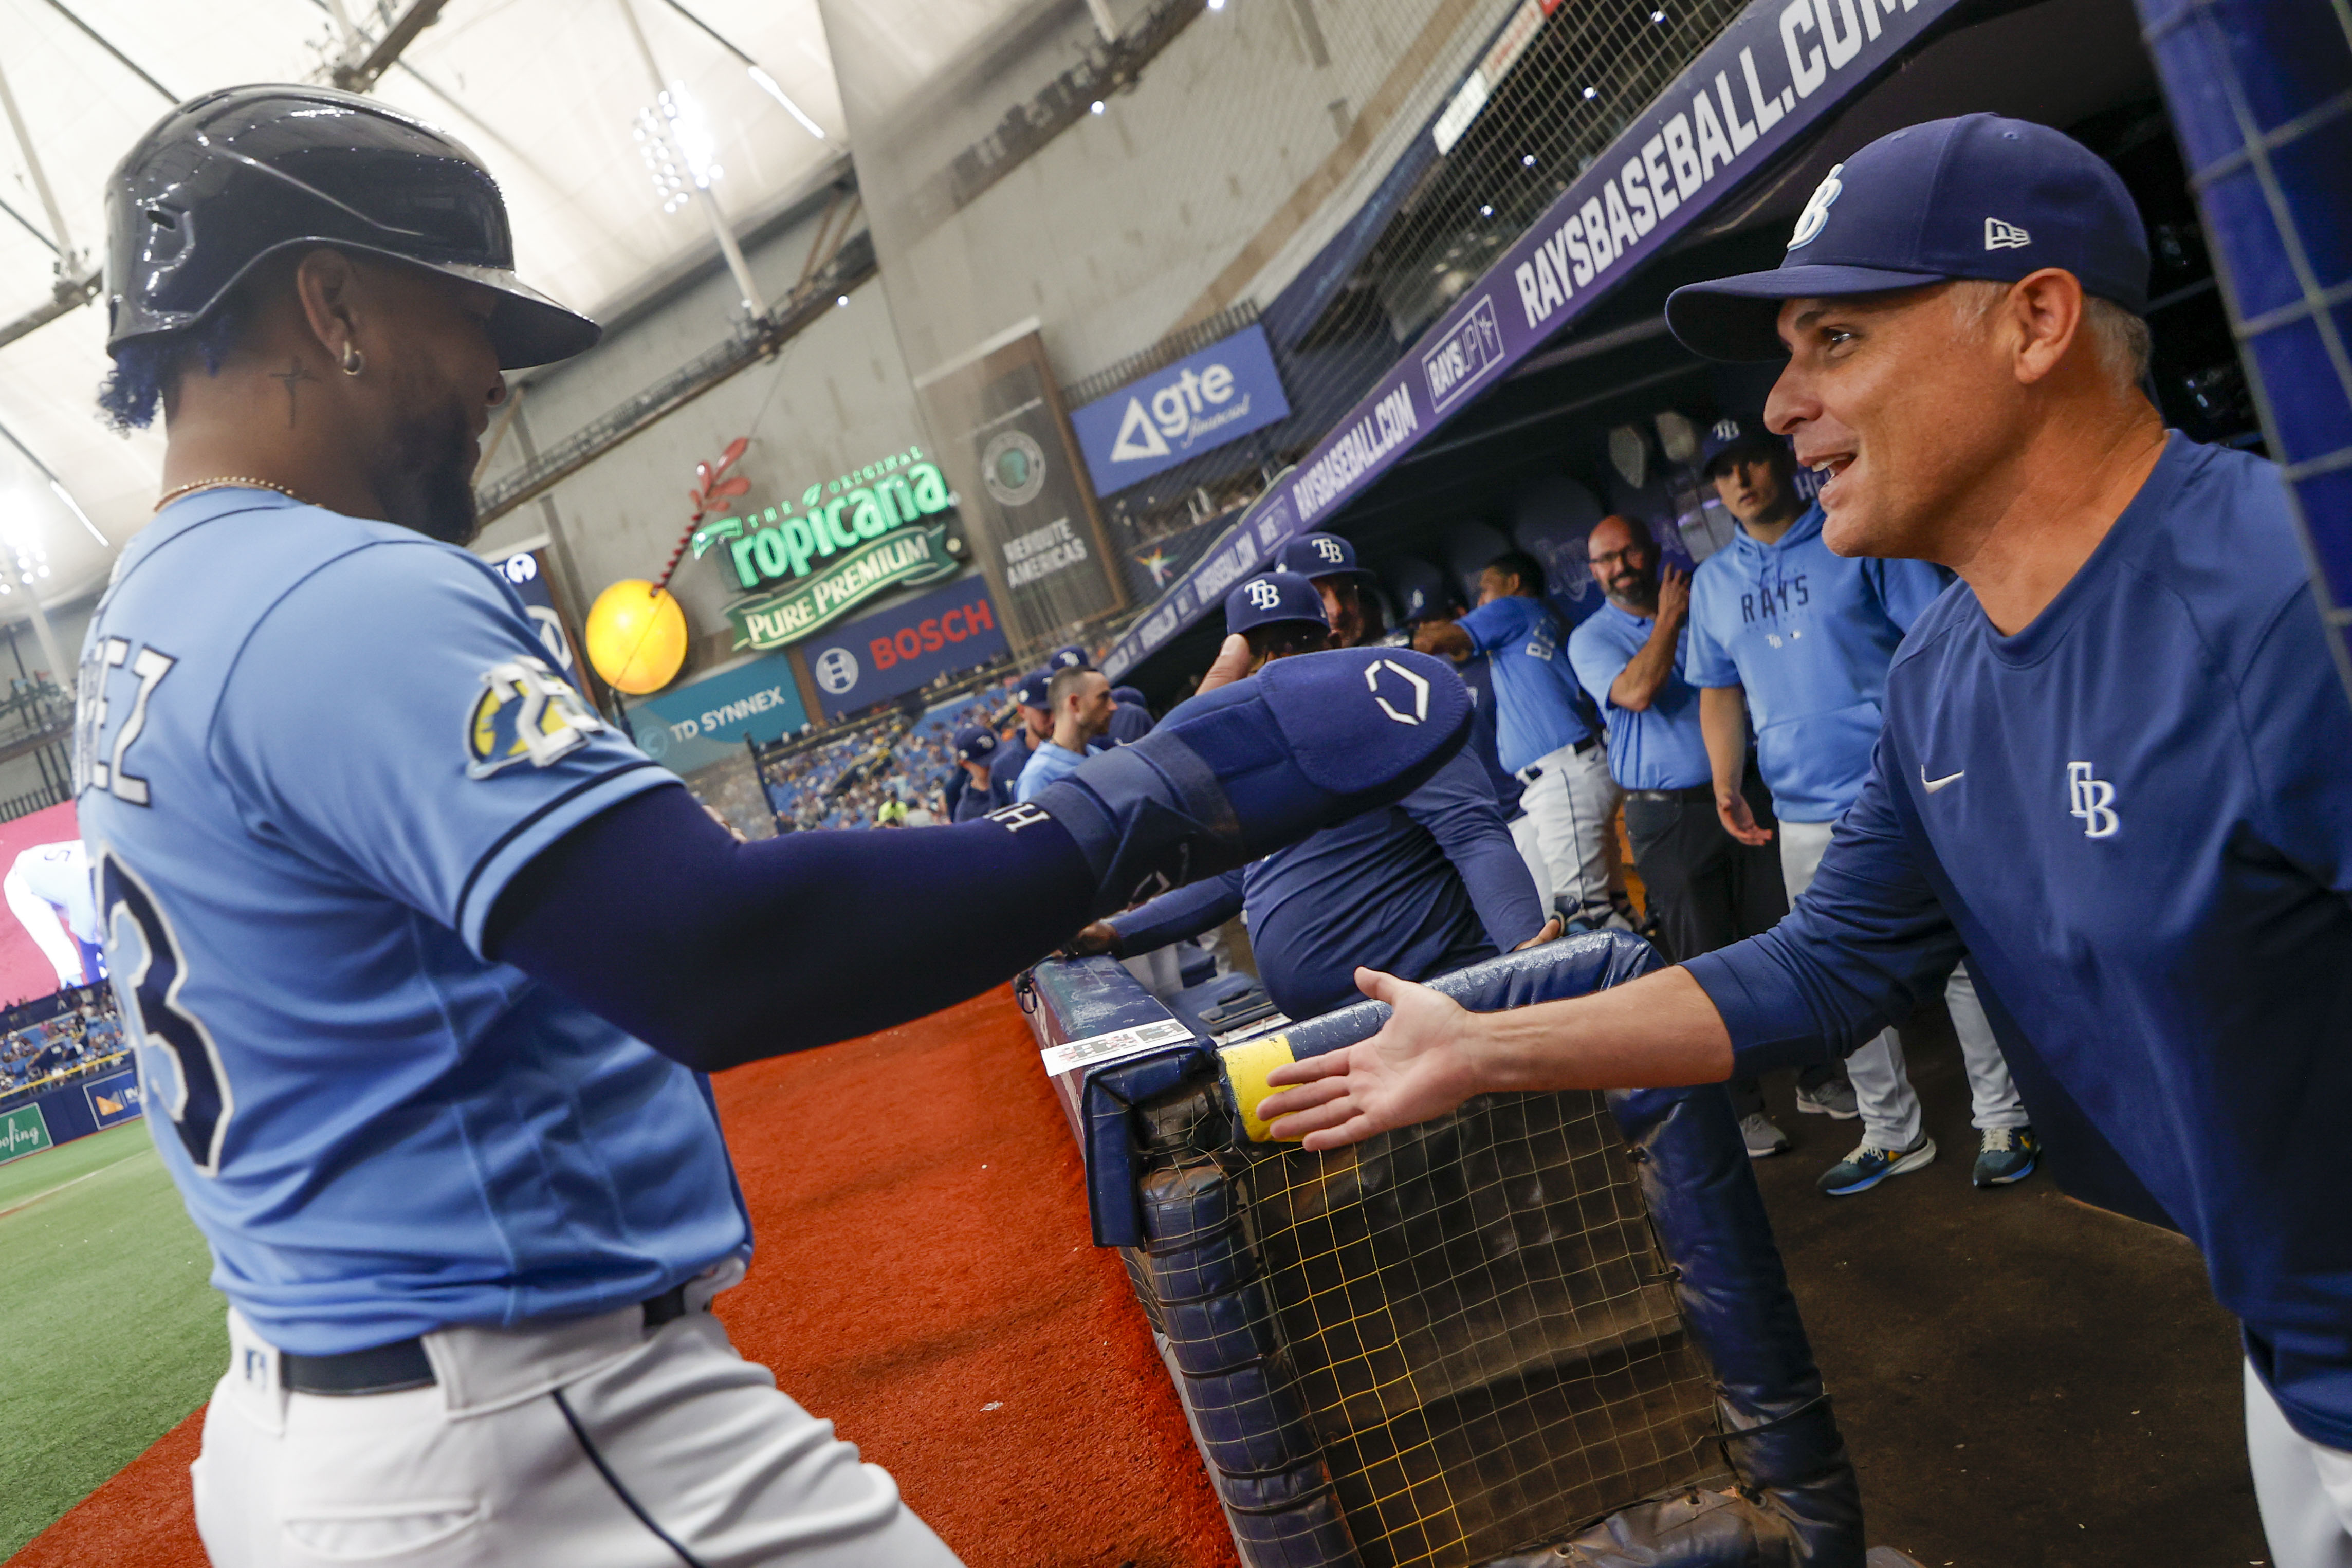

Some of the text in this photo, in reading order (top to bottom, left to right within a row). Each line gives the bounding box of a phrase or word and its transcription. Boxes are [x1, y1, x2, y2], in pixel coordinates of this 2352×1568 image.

[1152, 363, 1234, 438] gte
[747, 445, 923, 528] THE ORIGINAL
[1292, 381, 1419, 522] RAYSBASEBALL.COM
[692, 461, 949, 588] Tropicana
[1311, 538, 1345, 564] TB
[744, 534, 931, 643] PURE PREMIUM
[1244, 579, 1281, 611] TB
[1741, 574, 1809, 623] RAYS
[869, 599, 994, 671] BOSCH
[670, 686, 785, 743] TD SYNNEX
[2067, 761, 2120, 838] TB
